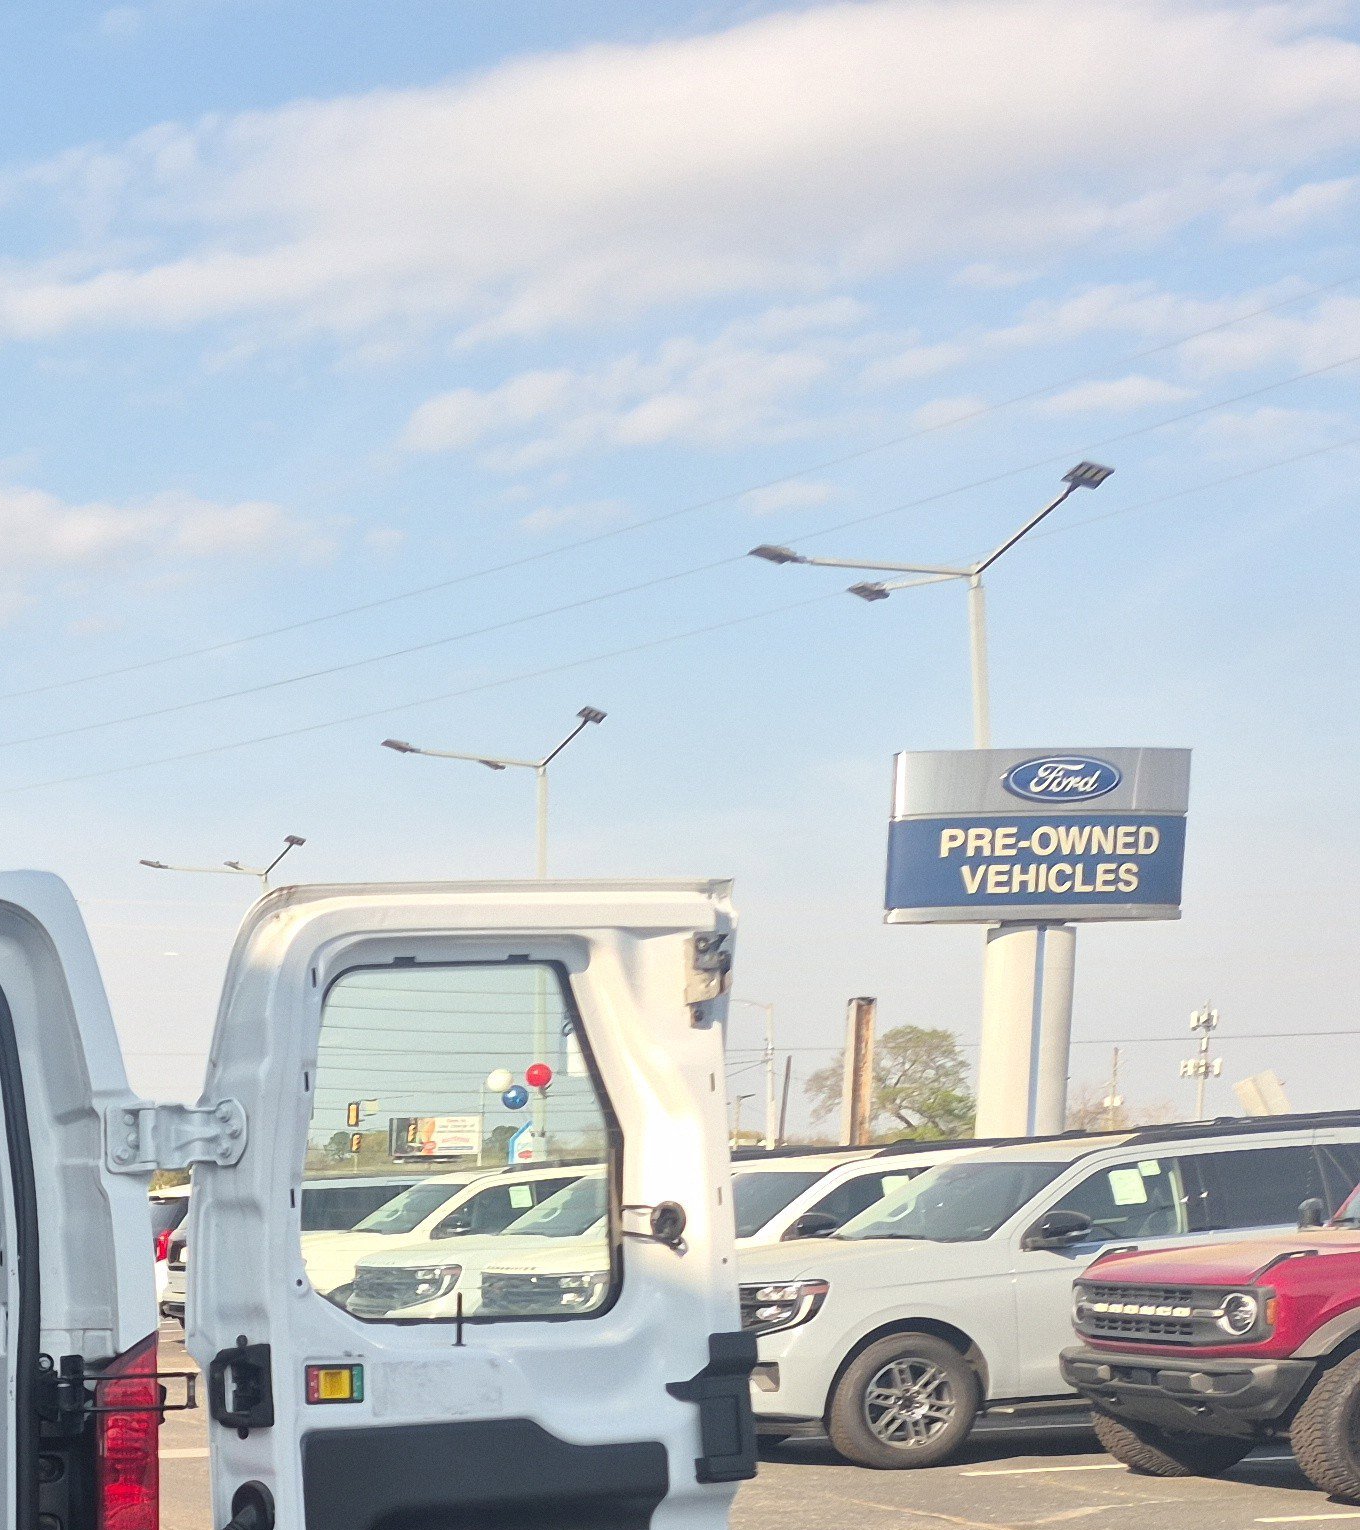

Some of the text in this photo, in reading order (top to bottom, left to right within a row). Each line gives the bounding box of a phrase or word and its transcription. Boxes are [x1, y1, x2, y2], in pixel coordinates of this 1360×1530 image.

[1030, 763, 1103, 794] Ford
[939, 825, 1160, 858] PRE-OWNED
[960, 862, 1139, 894] VEHICLES
